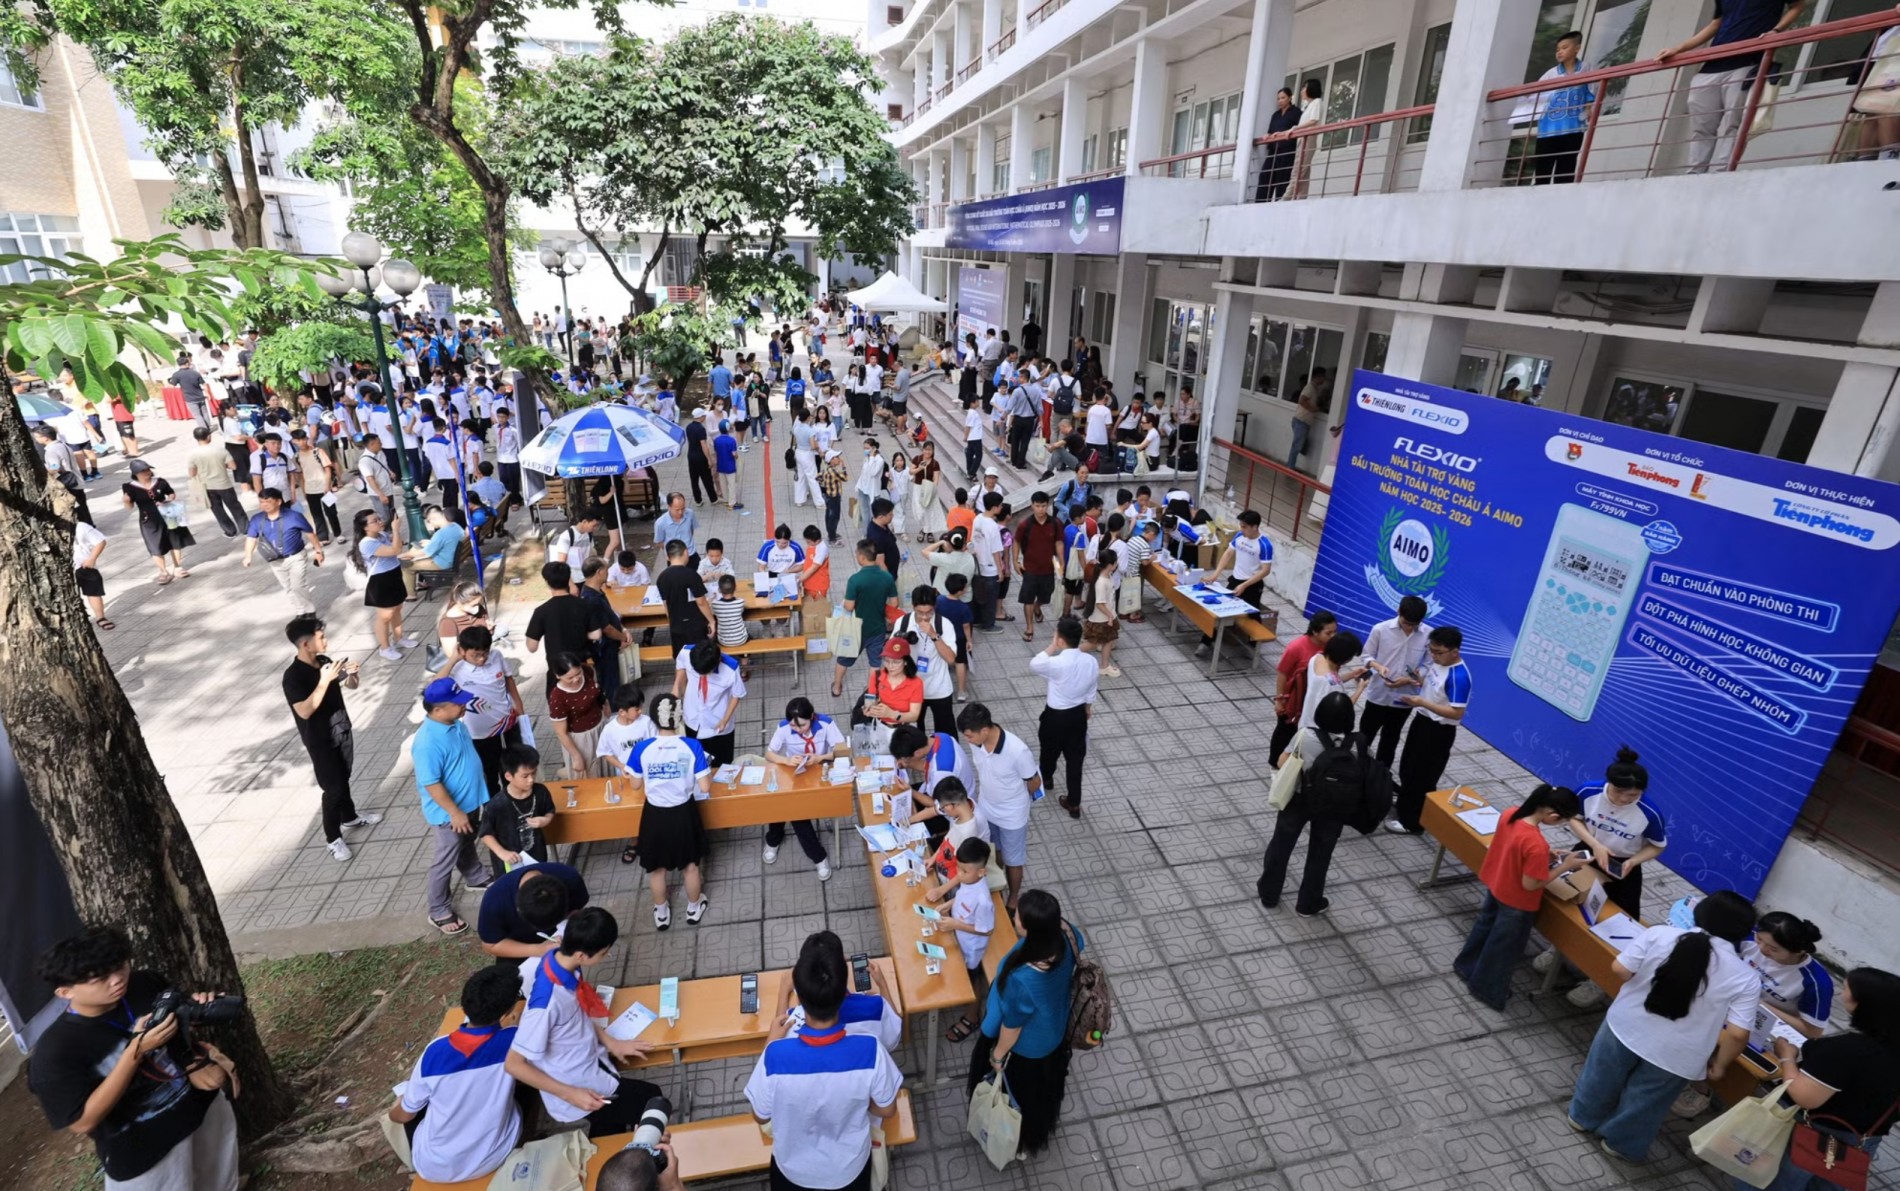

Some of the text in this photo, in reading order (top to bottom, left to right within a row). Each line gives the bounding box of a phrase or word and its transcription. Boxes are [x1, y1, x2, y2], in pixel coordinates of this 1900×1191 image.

[1412, 408, 1460, 427] FLEXIO
[634, 451, 674, 469] FLEXIO
[1394, 436, 1477, 472] FLEXIO
[1645, 448, 1661, 457] ĐƠN
[1662, 452, 1670, 460] VỊ
[1682, 456, 1704, 467] CHỨC
[1352, 454, 1524, 528] ĐẤU TRƯỜNG TOÁN HỌC CHÂU Á AIMO
[1390, 454, 1476, 492] NHÀ TÀI TRỢ VÀNG
[1379, 482, 1399, 498] NĂM
[1400, 492, 1419, 506] HỌC
[1448, 509, 1472, 527] 2026
[1582, 486, 1597, 495] MÁY
[1615, 496, 1634, 506] KHOA
[1635, 503, 1651, 511] HỌC
[1785, 480, 1875, 507] ĐƠN VỊ THỰC HIỆN
[1393, 534, 1429, 563] AIMO
[1661, 572, 1820, 621] ĐẠT CHUẨN VÀO PHÒNG THI
[1645, 601, 1826, 683] ĐỘT PHÁ HÌNH HỌC KHÔNG GIAN
[1639, 632, 1791, 723] TỐI ƯU DỮ LIỆU GHÉP NHÓM
